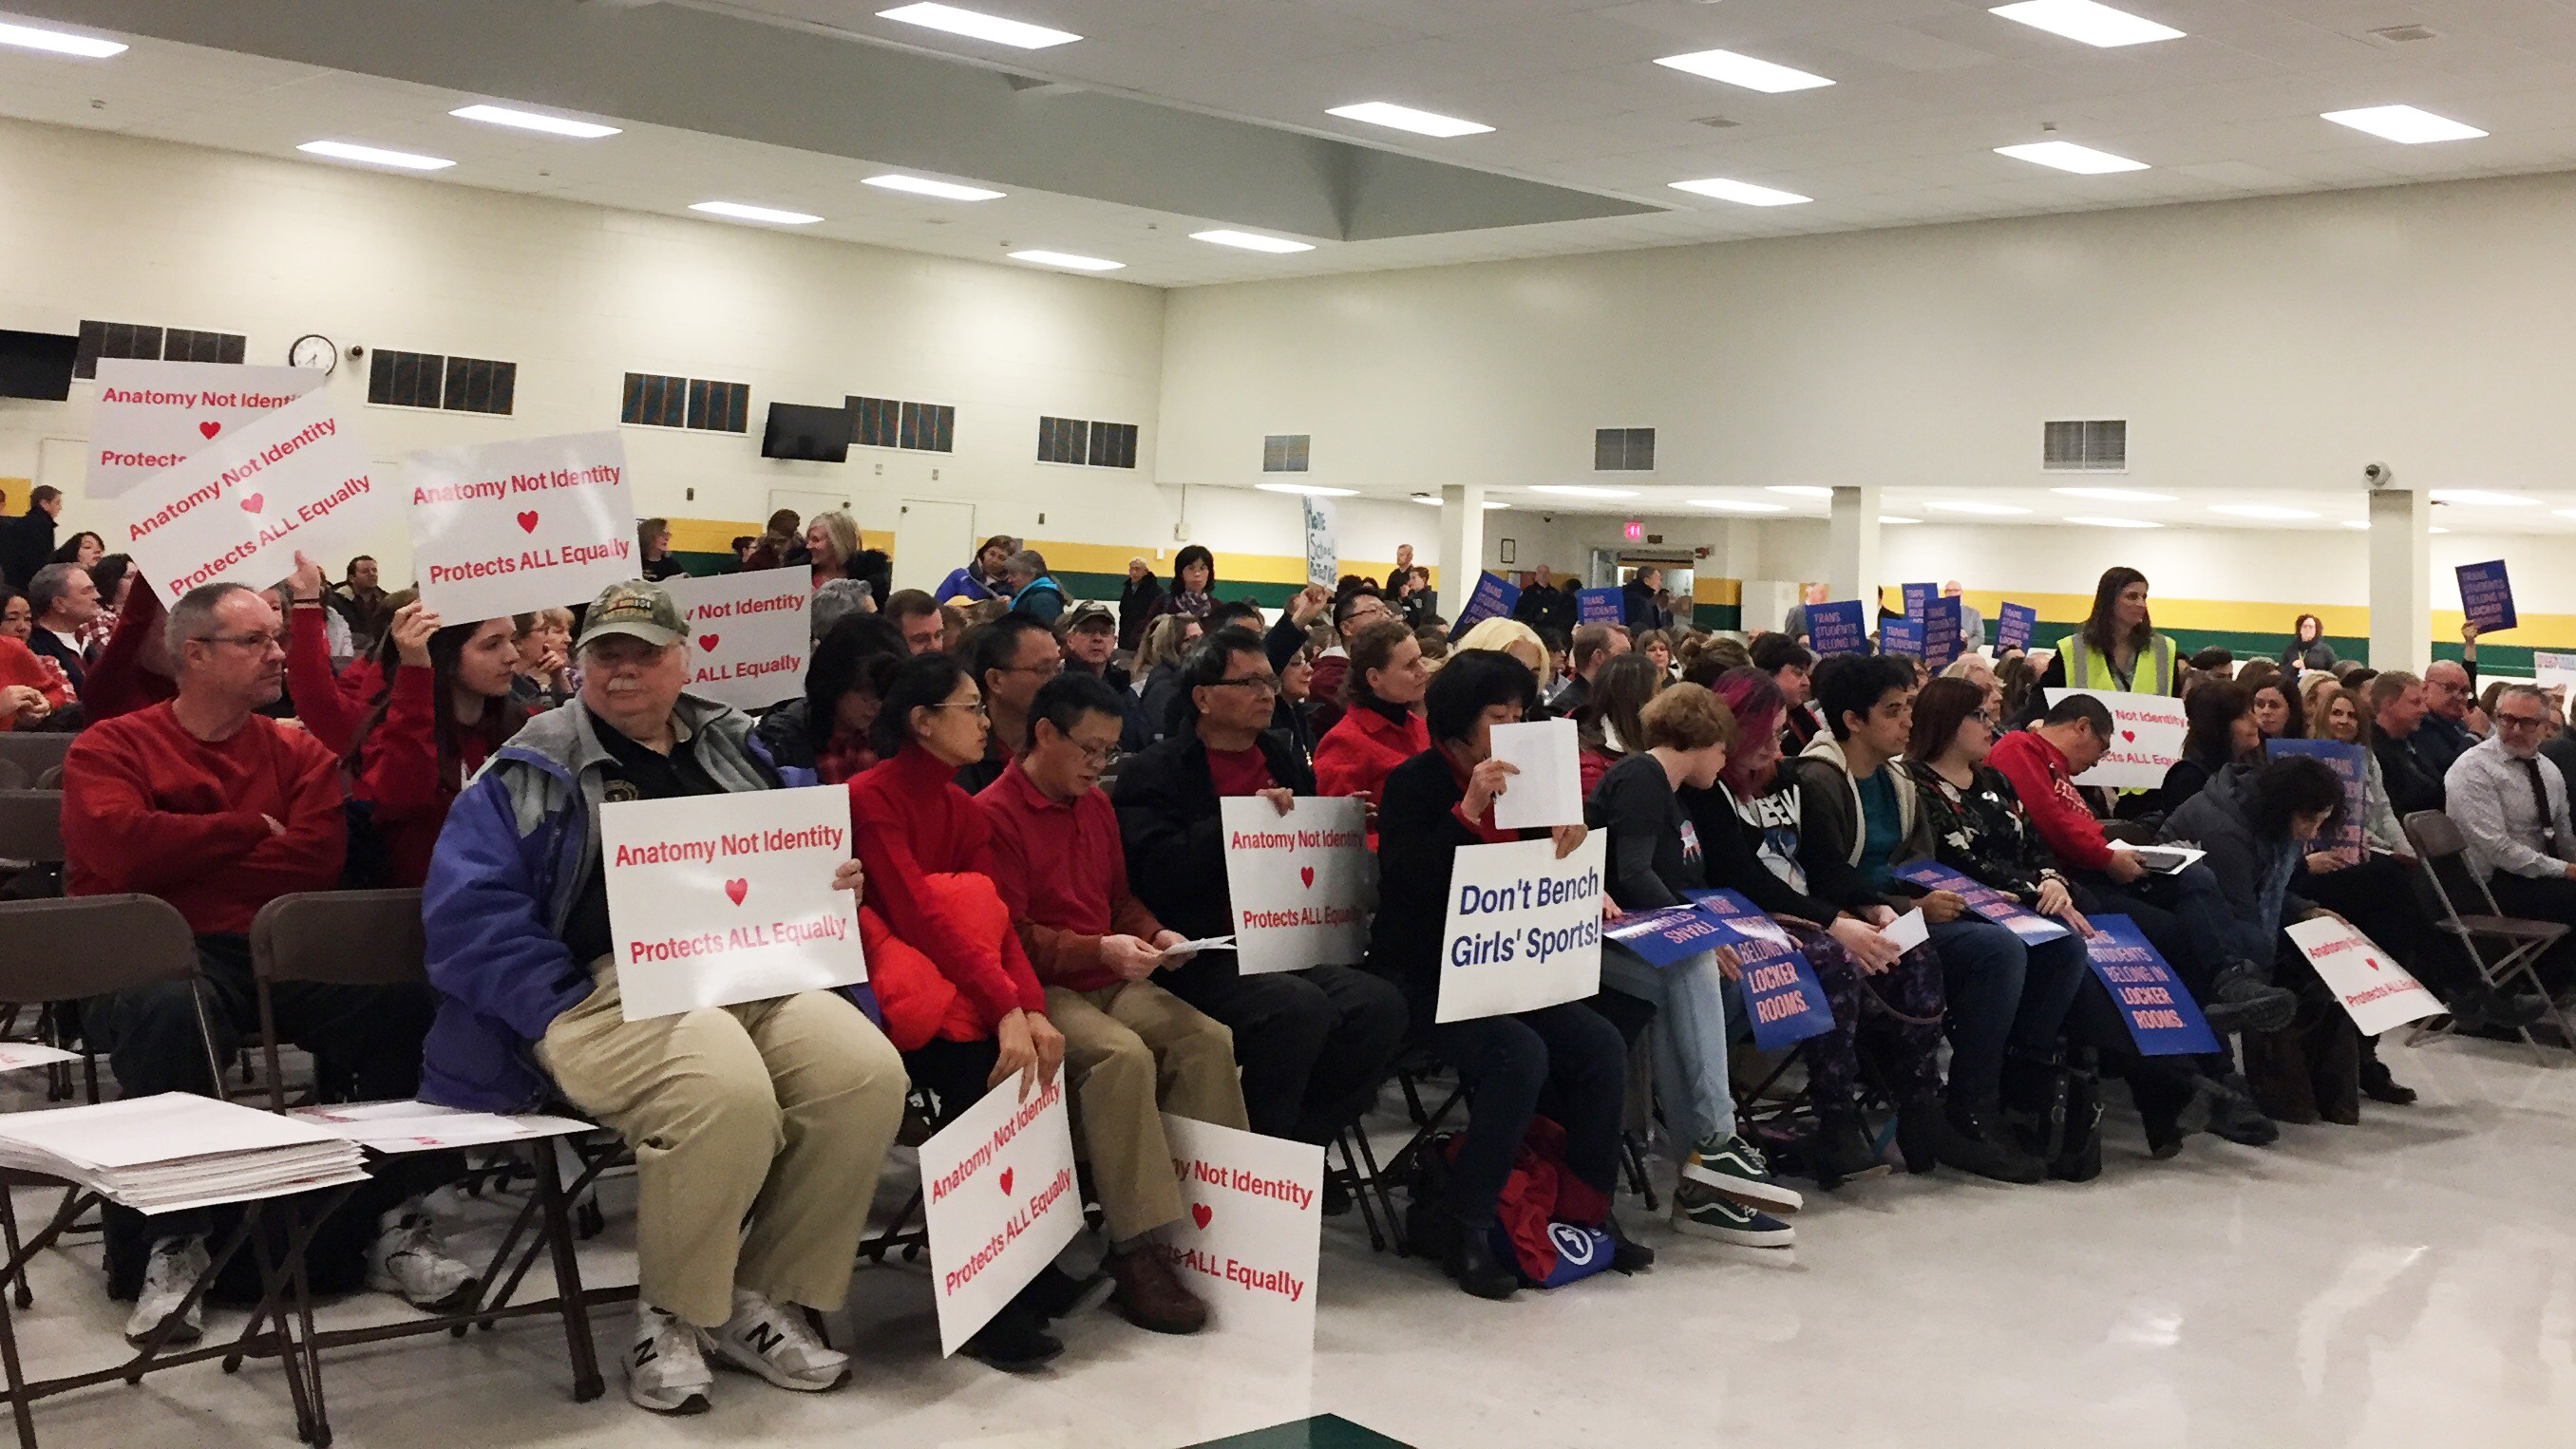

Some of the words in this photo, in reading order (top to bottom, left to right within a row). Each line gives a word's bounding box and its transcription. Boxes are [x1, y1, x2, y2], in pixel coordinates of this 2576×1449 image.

[102, 387, 197, 409] Anatomy
[201, 391, 237, 407] Not
[241, 392, 303, 408] Ident
[128, 480, 221, 540] Anatomy
[221, 457, 262, 487] Not
[260, 417, 337, 464] Identity
[412, 480, 507, 505] Anatomy
[511, 473, 547, 493] Not
[551, 464, 621, 488] Identity
[169, 540, 257, 595] Protects
[258, 518, 299, 547] ALL
[297, 474, 371, 523] Equally
[429, 555, 516, 584] Protects
[519, 550, 559, 570] ALL
[561, 537, 630, 568] Equally
[697, 600, 731, 620] Not
[735, 593, 805, 615] Identity
[696, 665, 731, 684] ALL
[735, 654, 802, 679] Equally
[2114, 709, 2137, 721] Not
[2139, 711, 2186, 728] Identity
[2127, 753, 2151, 764] ALL
[615, 839, 715, 867] Anatomy
[721, 833, 759, 856] Not
[763, 824, 843, 851] Identity
[1231, 830, 1296, 853] Anatomy
[1297, 829, 1321, 849] Not
[1322, 828, 1364, 849] Identity
[1460, 877, 1531, 915] Don't
[1537, 865, 1599, 908] Bench
[630, 933, 723, 964] Protects
[728, 925, 769, 949] ALL
[772, 914, 847, 946] Equally
[1242, 908, 1299, 930] Protects
[1301, 907, 1323, 926] ALL
[1450, 927, 1523, 968] Girls'
[1525, 914, 1600, 964] Sports!
[1748, 961, 1800, 994] LOCKER
[2117, 987, 2175, 1005] LOCKER
[1755, 989, 1810, 1024] ROOMS.
[932, 1142, 993, 1205] Anatomy
[994, 1119, 1016, 1154] Not
[1015, 1079, 1061, 1136] Identity
[1194, 1159, 1227, 1187] Not
[1232, 1168, 1314, 1211] Identity
[945, 1233, 1005, 1296] Protects
[1005, 1207, 1031, 1244] ALL
[1030, 1167, 1071, 1218] Equally
[1184, 1248, 1221, 1278] ALL
[1225, 1260, 1305, 1302] Equally
[745, 1321, 785, 1354] N
